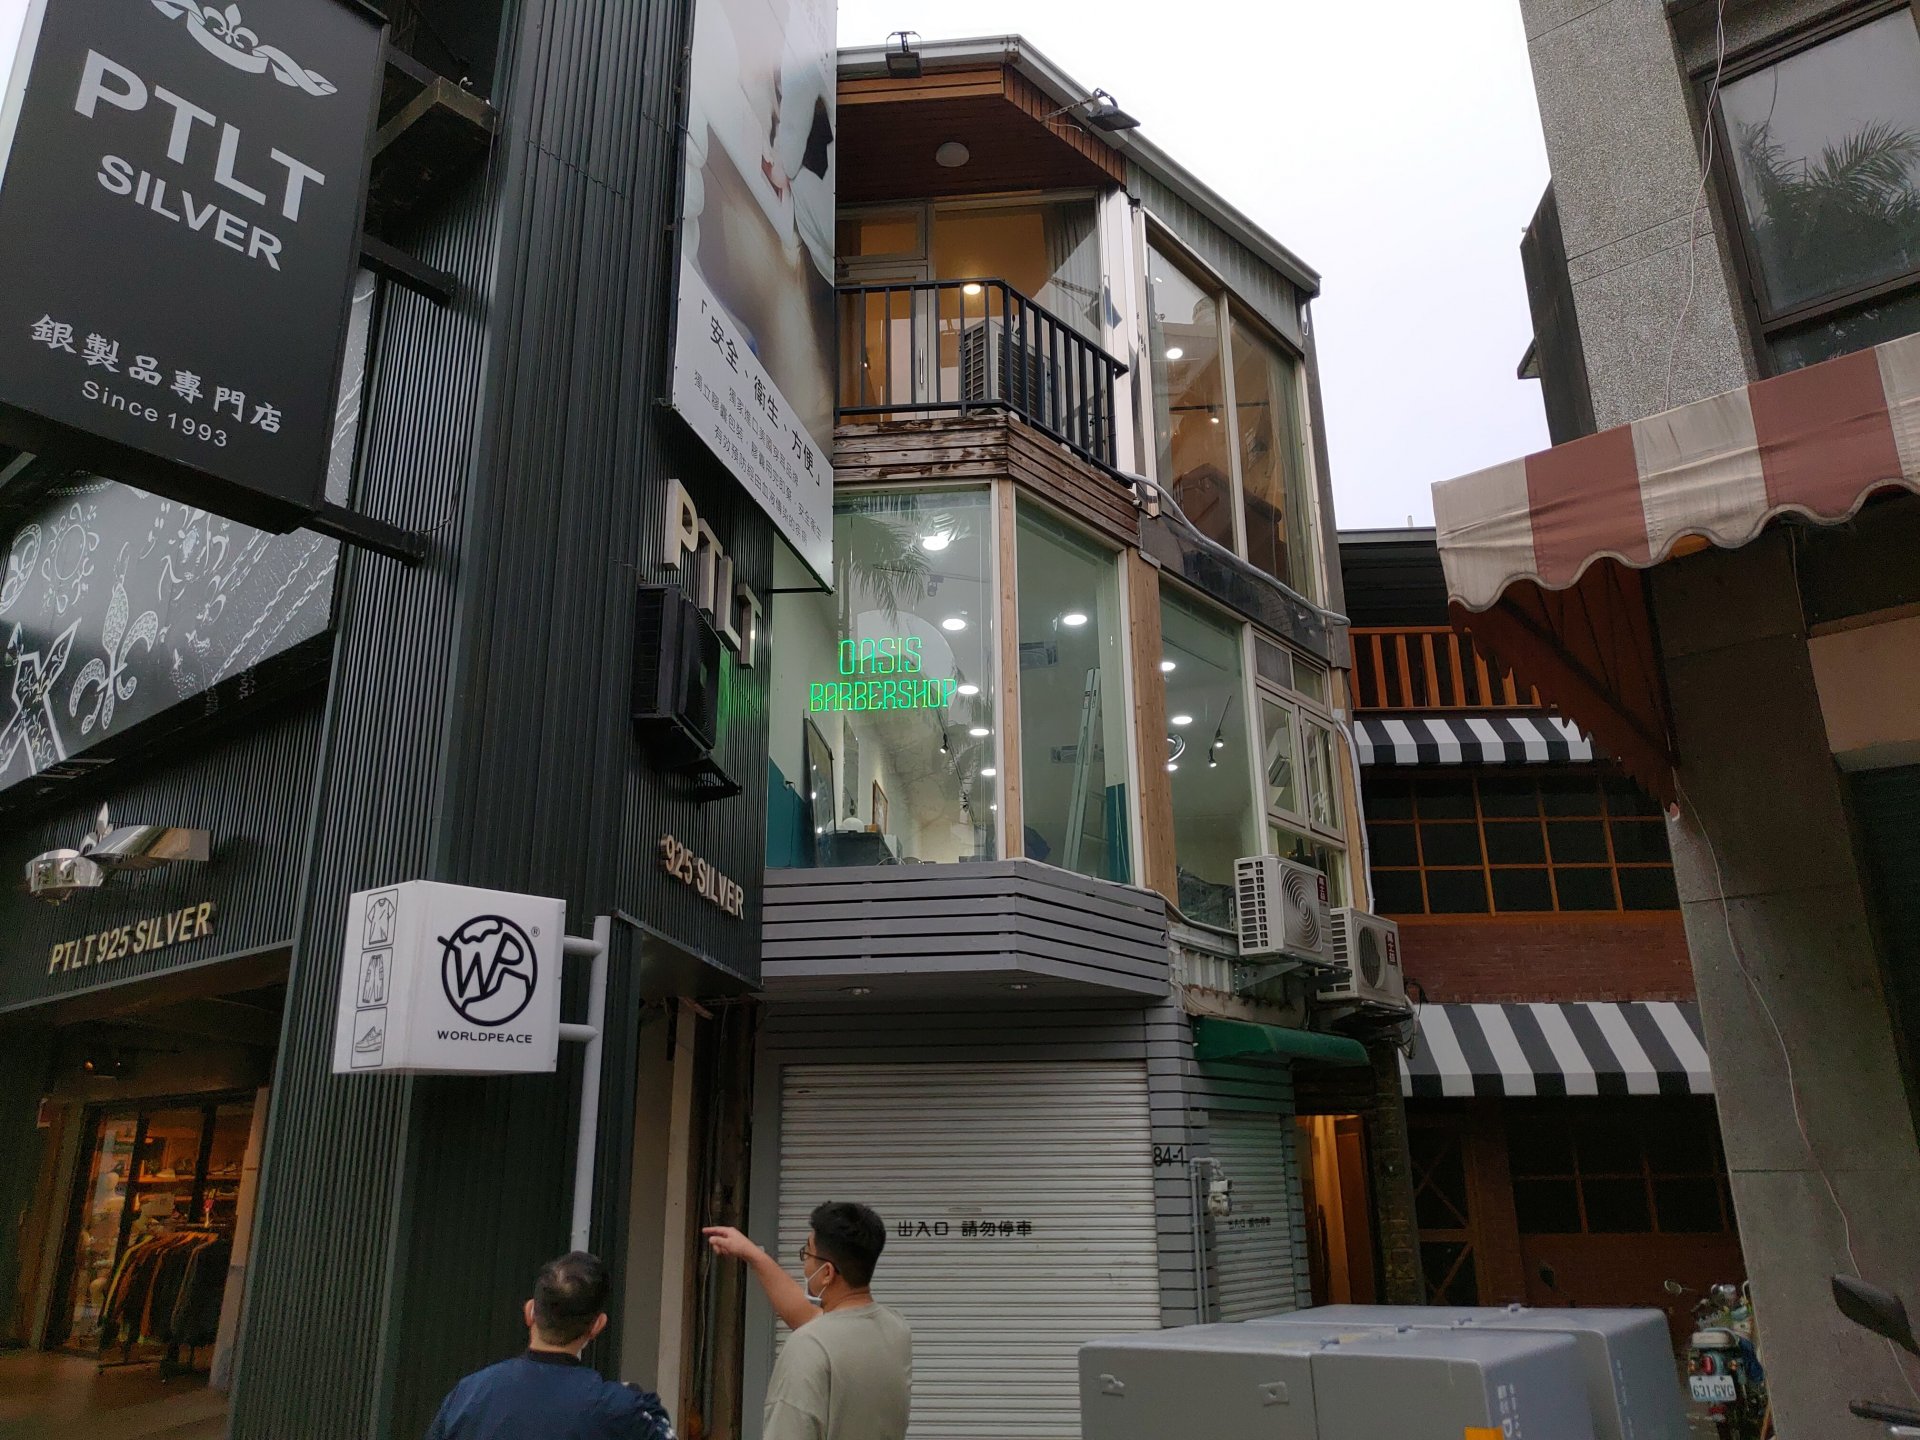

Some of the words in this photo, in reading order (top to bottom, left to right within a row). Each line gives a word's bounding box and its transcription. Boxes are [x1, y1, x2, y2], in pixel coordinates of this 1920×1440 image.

[74, 48, 325, 223] PTLT
[97, 154, 282, 271] SILVER
[31, 313, 282, 434] 銀製品專門店
[82, 380, 158, 423] Since
[168, 412, 228, 448] 1993
[663, 478, 763, 669] PTLT
[839, 637, 922, 675] OASIS
[810, 678, 957, 712] BARBERSHOP
[661, 834, 694, 885] 925
[695, 857, 744, 920] SILVER
[48, 932, 98, 975] PTLT
[96, 925, 131, 965] 925
[133, 901, 213, 955] SILVER
[437, 1030, 533, 1044] WORLDPEACE
[1153, 1146, 1185, 1167] 84-1
[898, 1220, 950, 1237] 出入口
[961, 1220, 1032, 1237] 請勿停車
